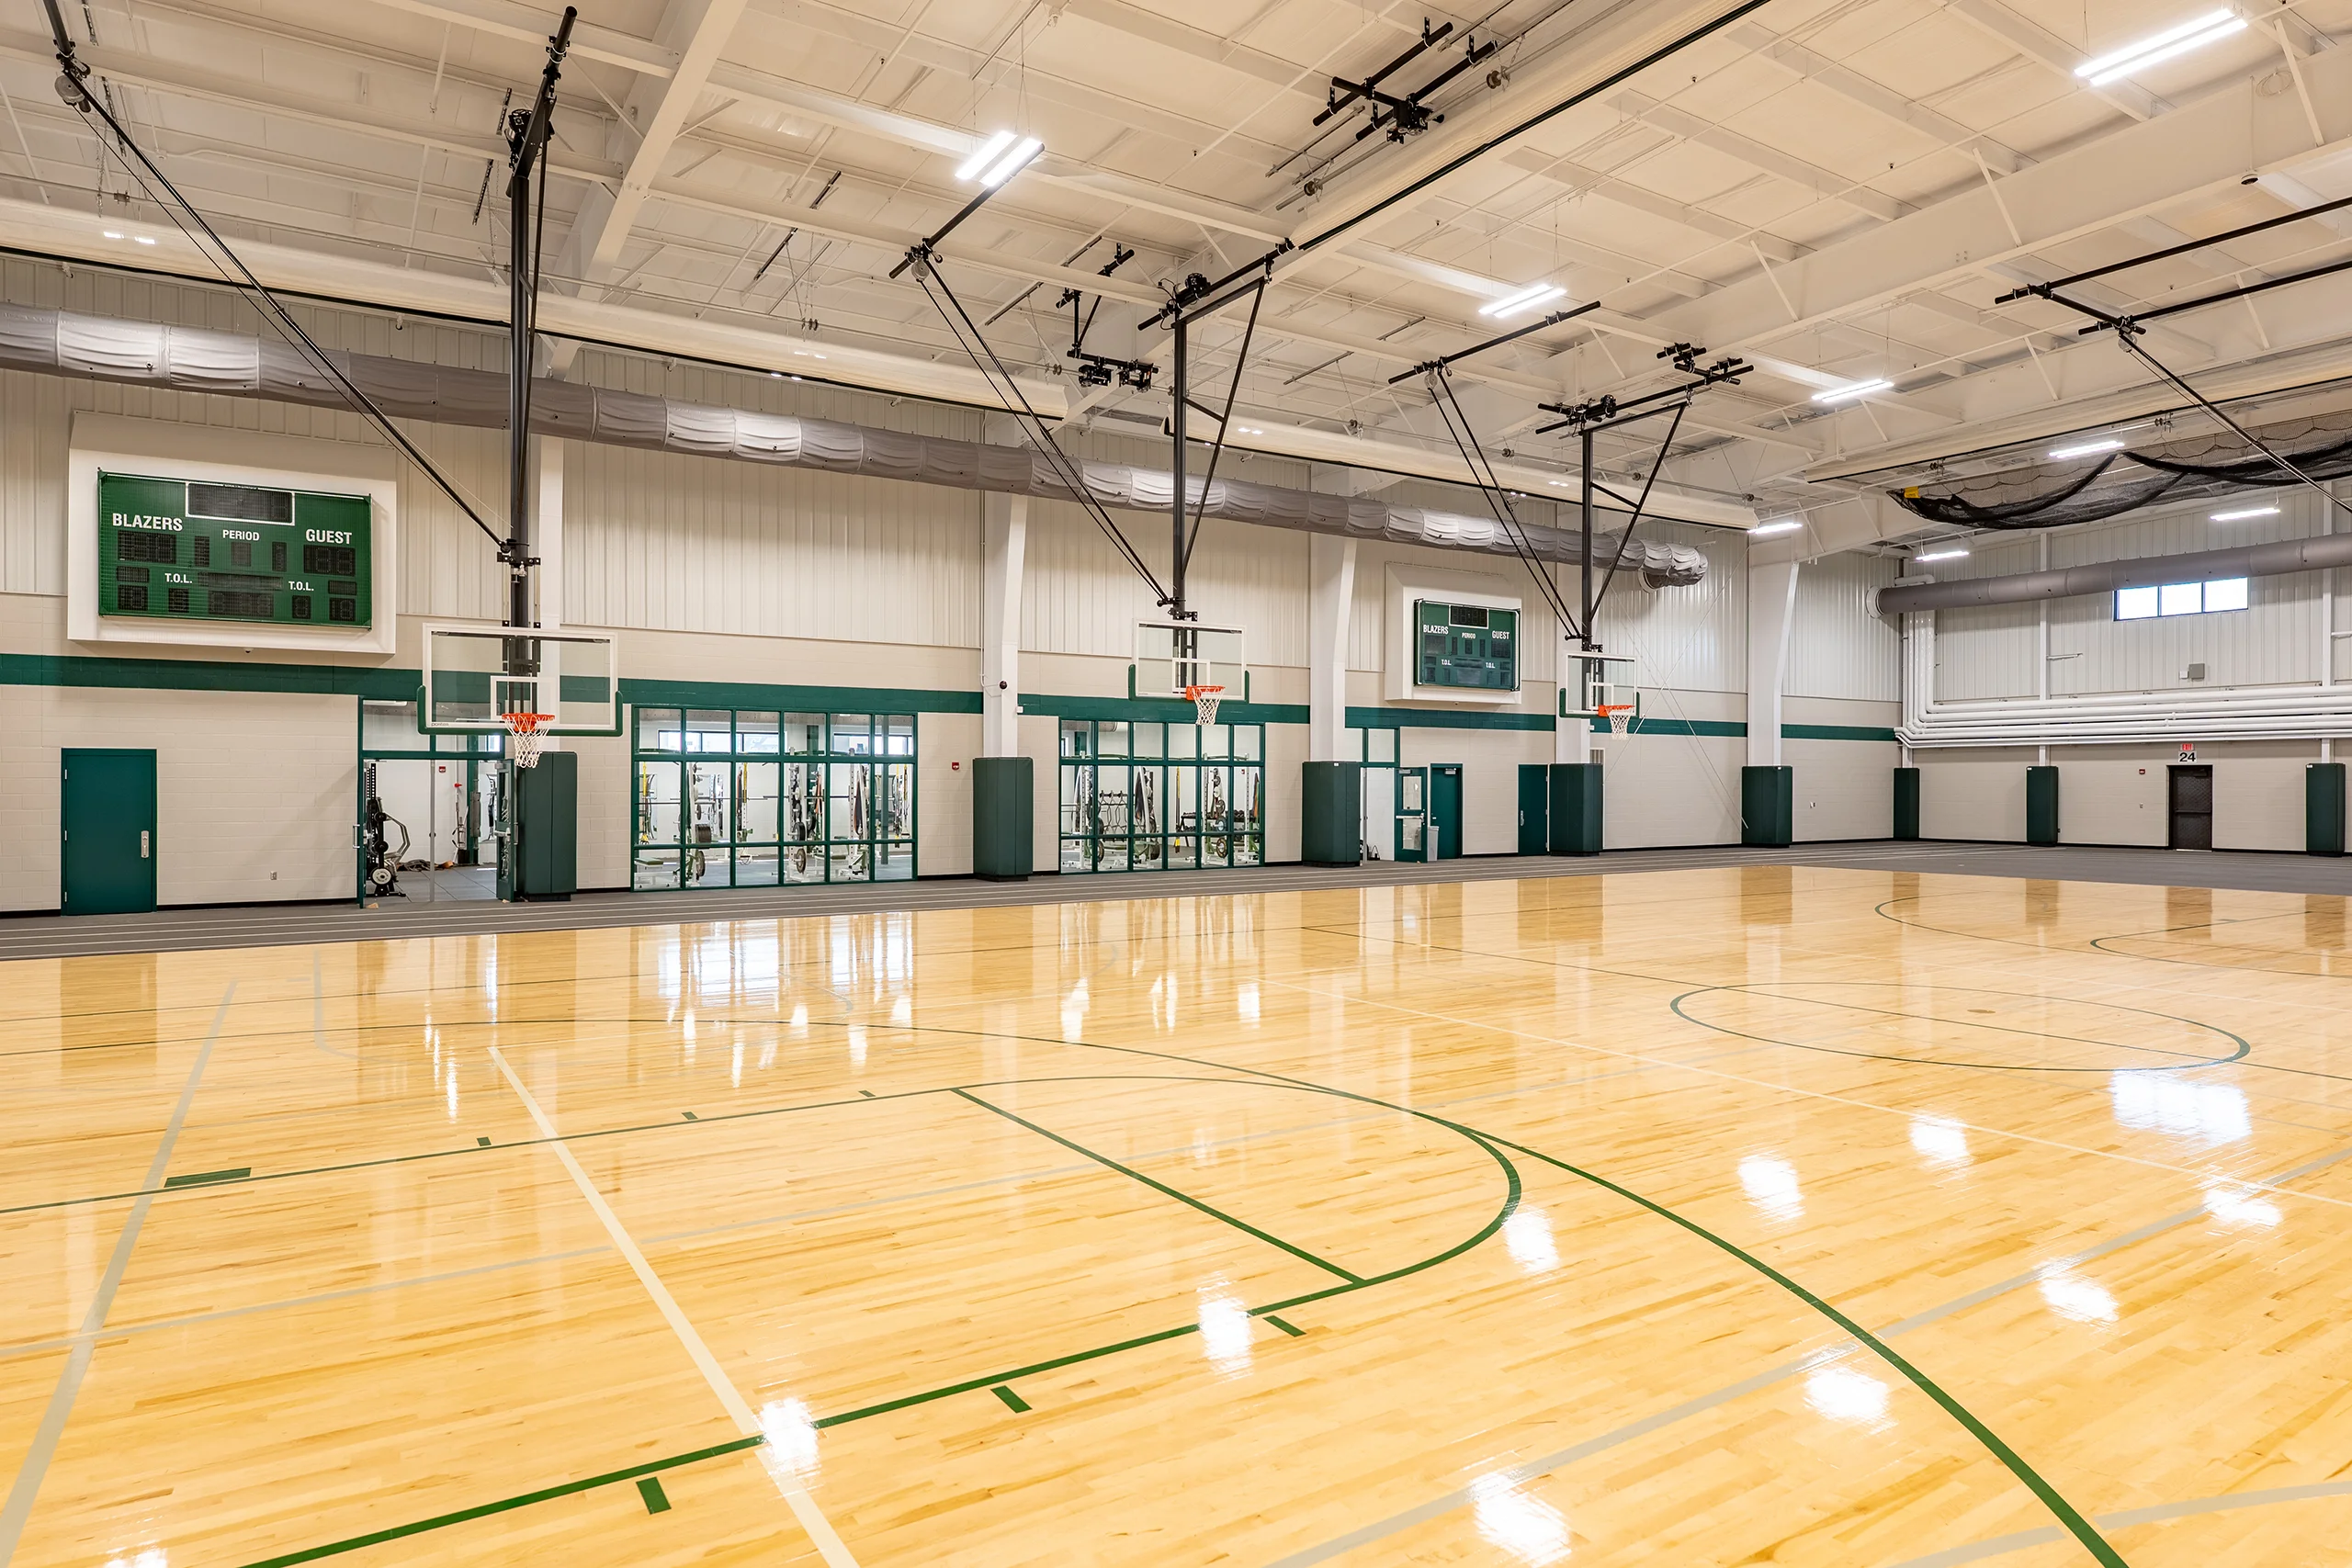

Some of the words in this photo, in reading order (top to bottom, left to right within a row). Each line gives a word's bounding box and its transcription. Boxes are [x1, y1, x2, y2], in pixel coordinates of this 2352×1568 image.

[112, 513, 183, 532] BLAZERS
[222, 529, 260, 541] PERIOD
[305, 528, 353, 545] GUEST
[164, 572, 193, 583] T.O.L.
[288, 581, 314, 591] T.O.L.
[1423, 624, 1449, 635] BLAZERS
[1491, 630, 1510, 639] GUEST
[2179, 751, 2196, 762] 24
